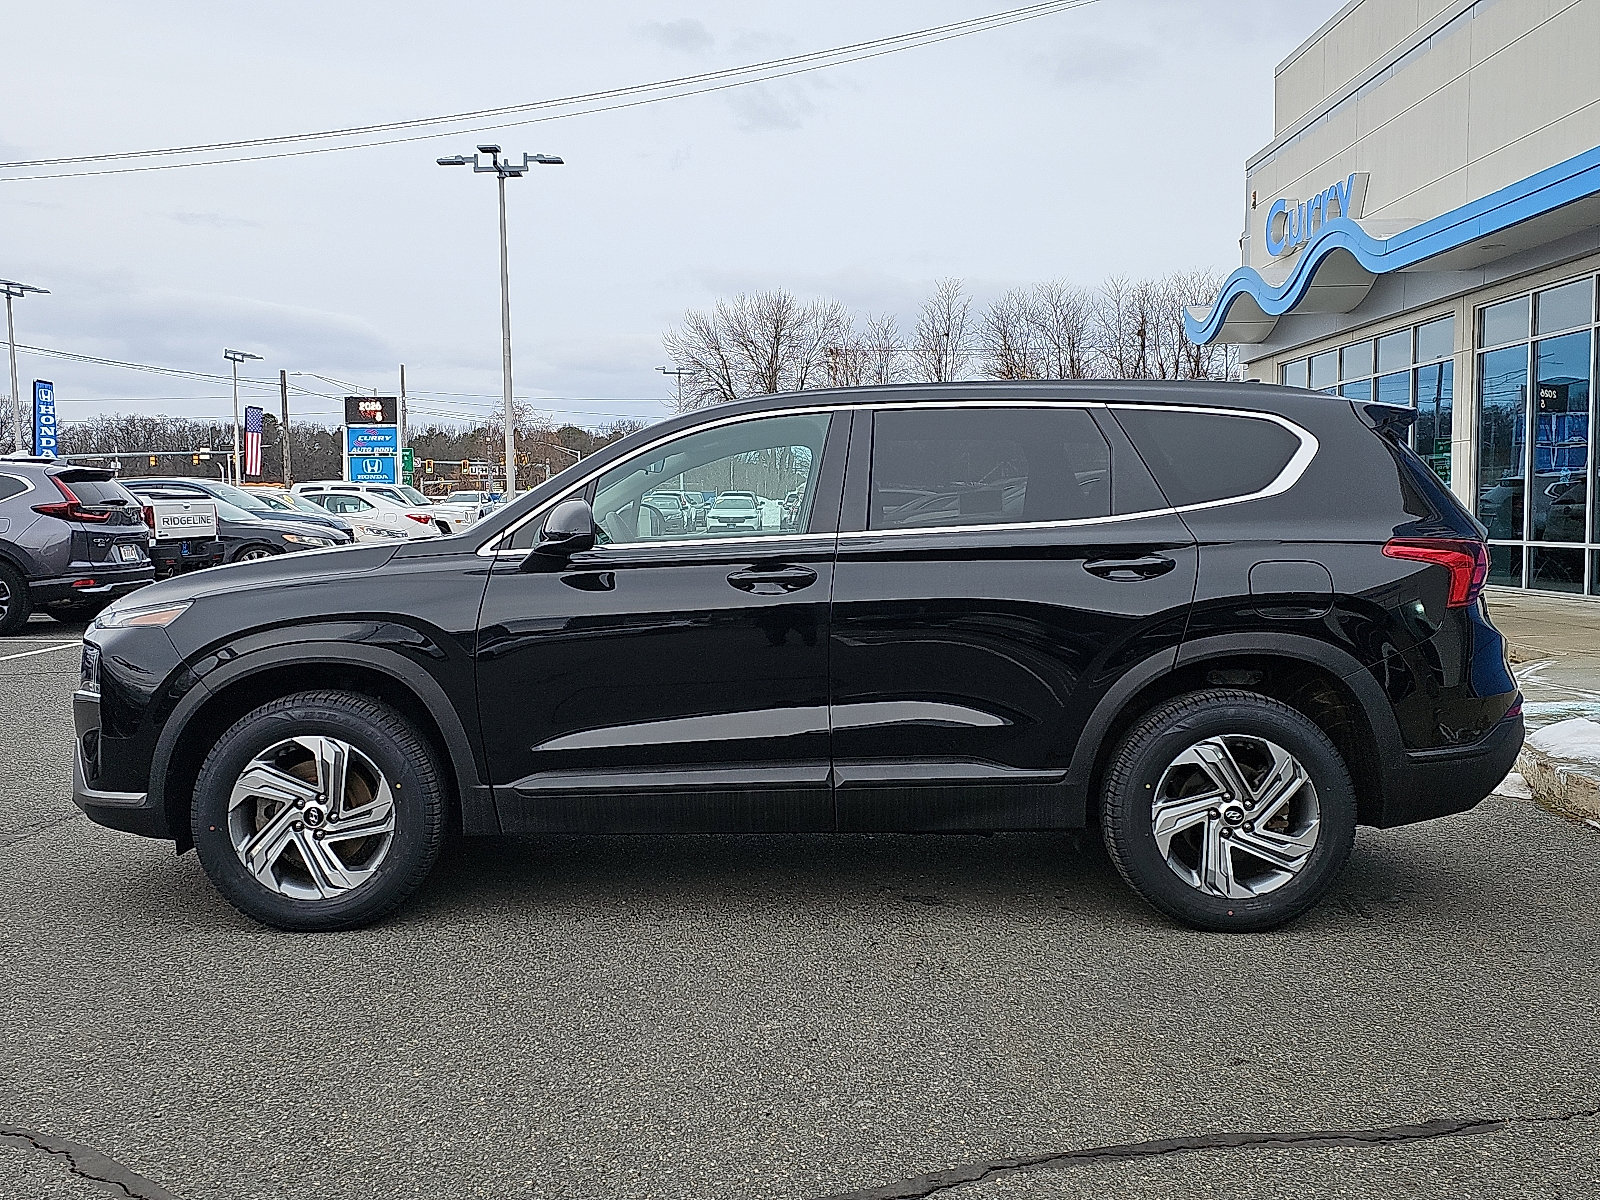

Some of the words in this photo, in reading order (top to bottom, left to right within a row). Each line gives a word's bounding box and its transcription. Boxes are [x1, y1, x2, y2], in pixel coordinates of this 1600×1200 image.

[1265, 173, 1364, 256] Curry
[358, 401, 383, 411] 2026
[38, 404, 56, 458] HONDA
[162, 515, 212, 527] RIDGELINE
